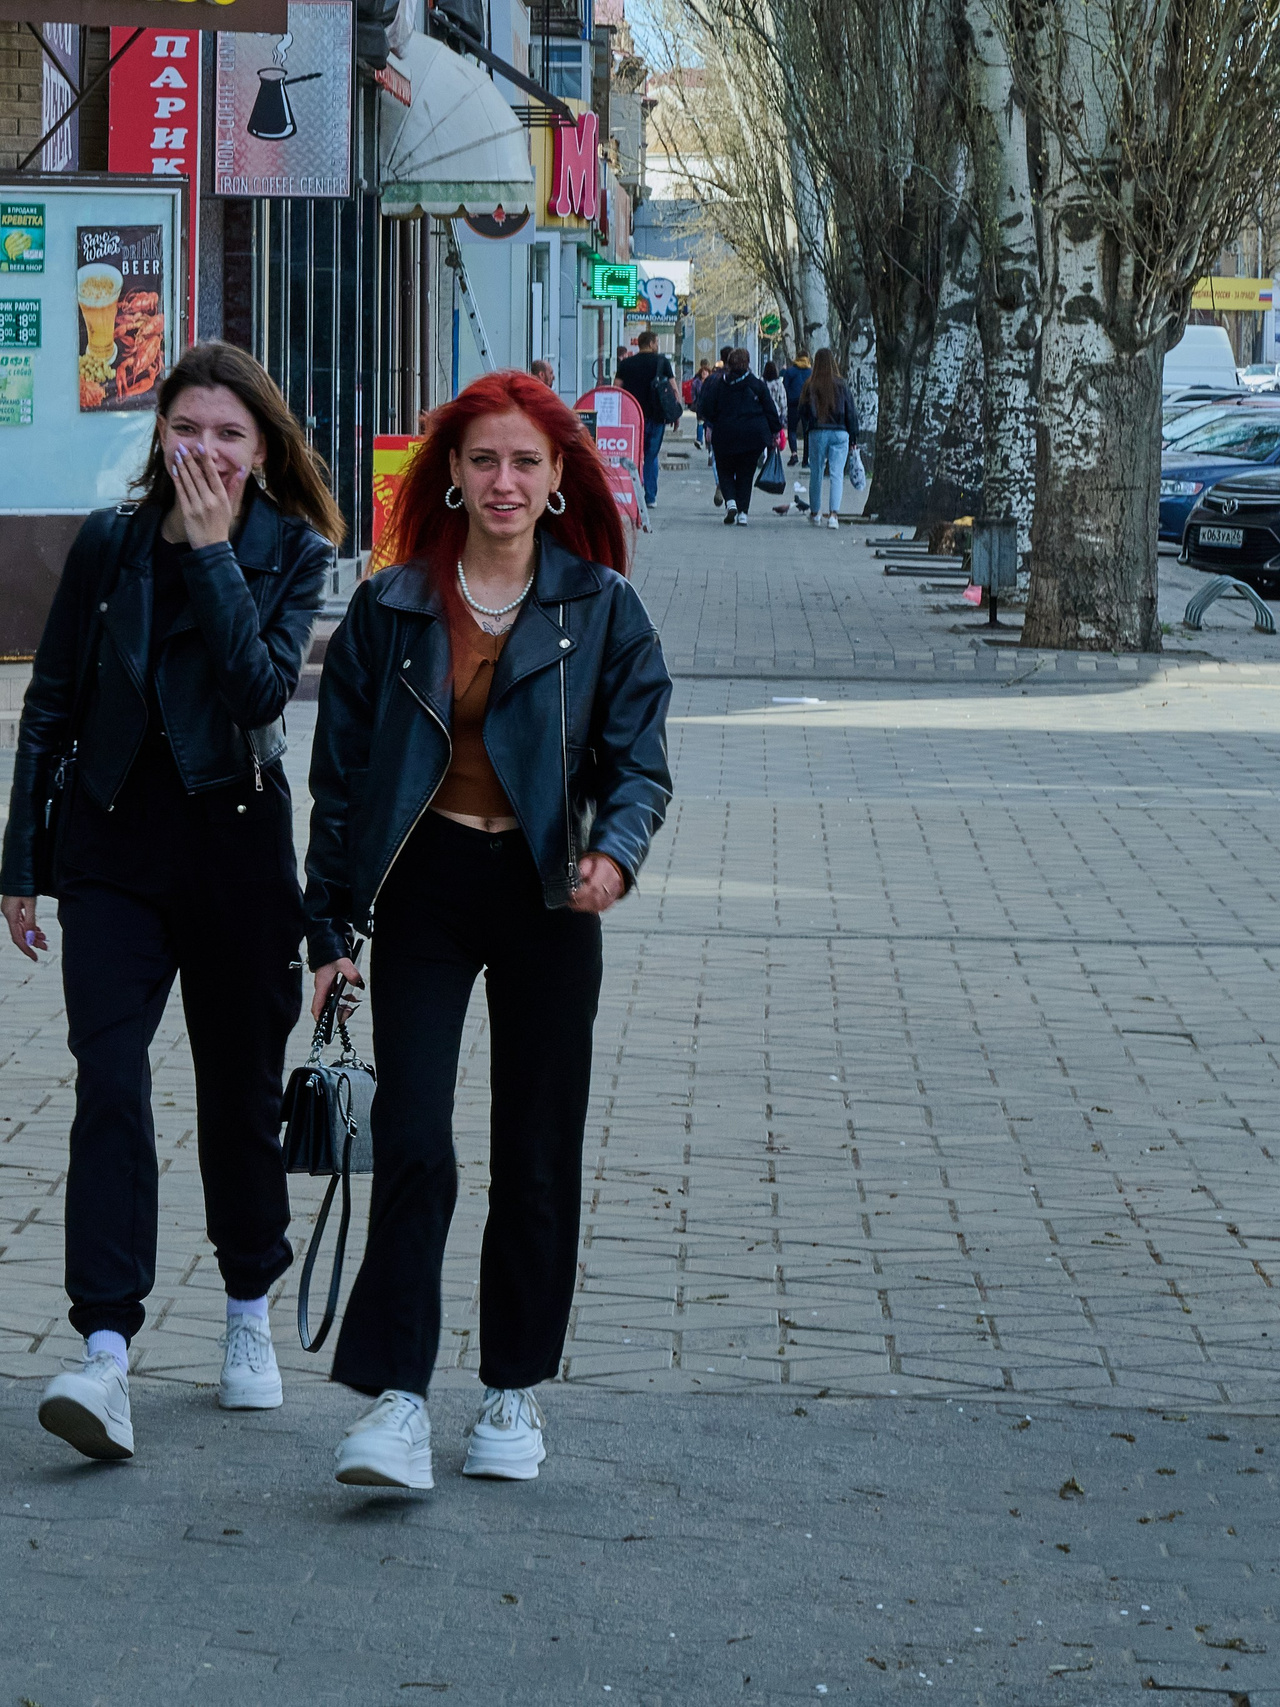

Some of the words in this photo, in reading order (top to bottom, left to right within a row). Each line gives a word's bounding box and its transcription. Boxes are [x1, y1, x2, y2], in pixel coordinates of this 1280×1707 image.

[218, 31, 236, 71] CENTE
[218, 84, 234, 129] COFFEE
[218, 137, 234, 173] IRON
[221, 177, 248, 193] IRON
[253, 177, 295, 193] COFFEE
[300, 178, 348, 194] CENTER
[1, 215, 43, 226] КРЕВЕТКА
[83, 232, 109, 249] Save
[122, 231, 160, 260] DRINK
[83, 237, 120, 262] Water
[122, 260, 160, 275] BEER
[15, 302, 39, 311] РАБОТЫ
[597, 438, 627, 451] ЯСО
[1202, 529, 1231, 542] К063УА
[1232, 530, 1241, 539] 26
